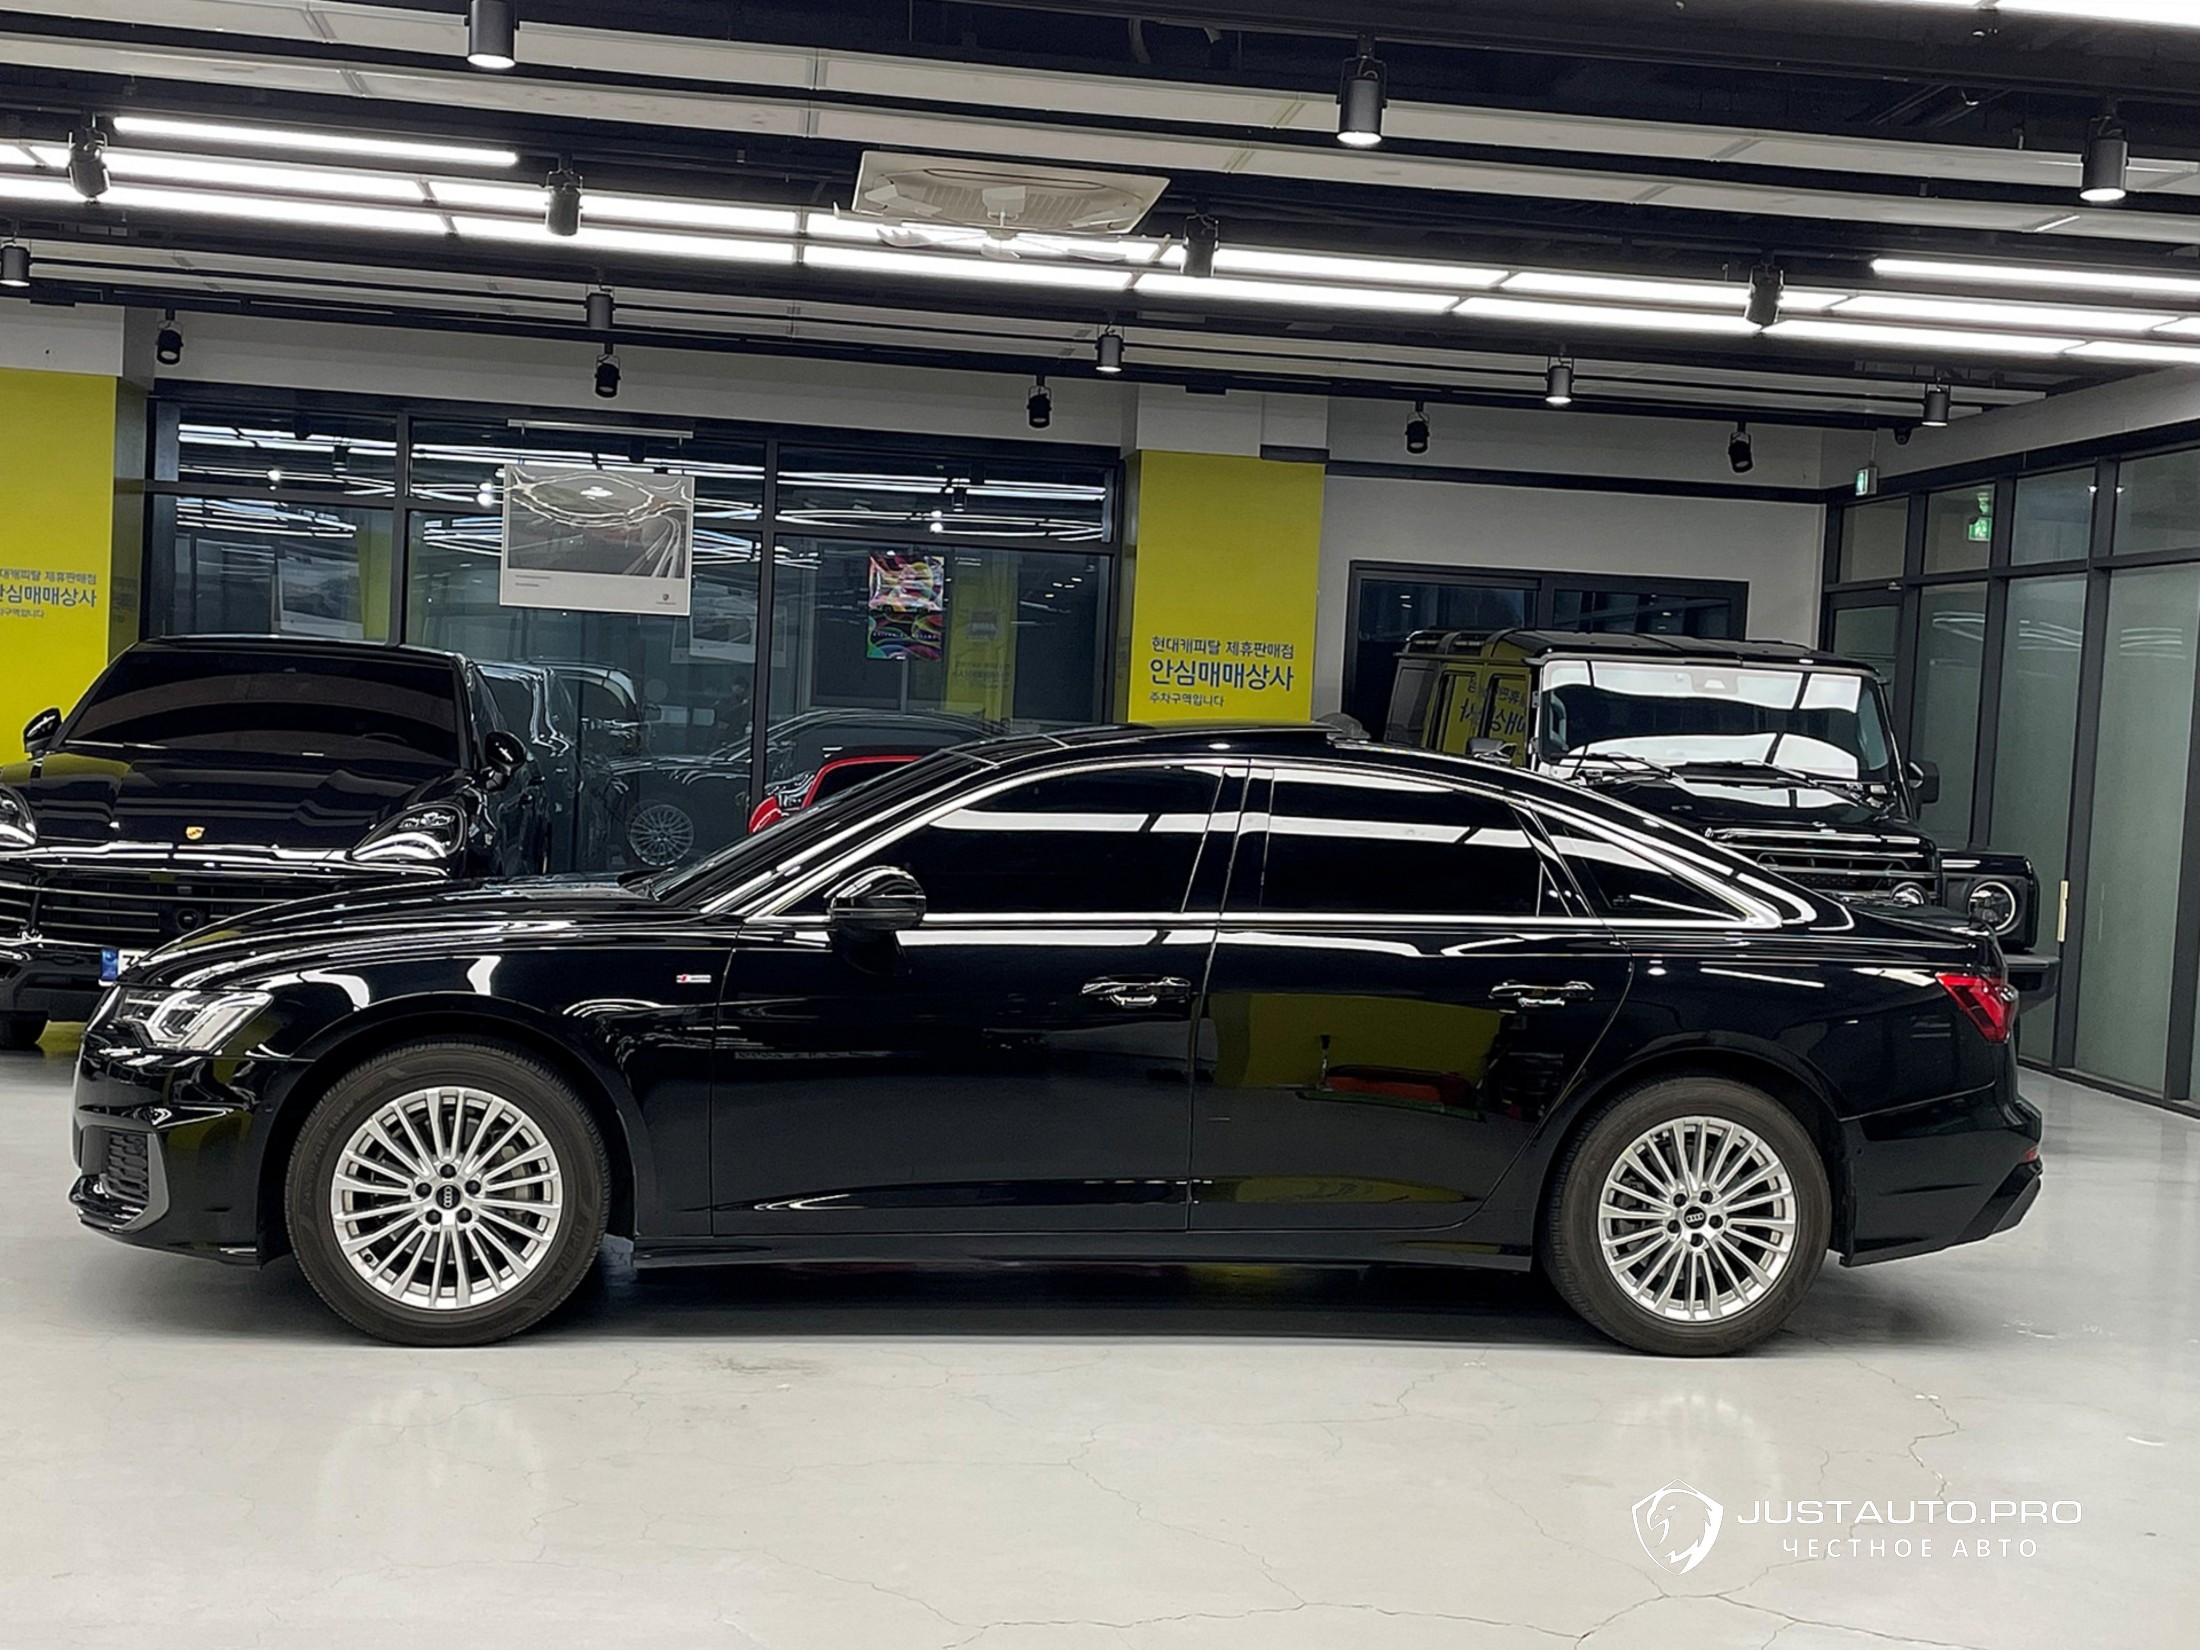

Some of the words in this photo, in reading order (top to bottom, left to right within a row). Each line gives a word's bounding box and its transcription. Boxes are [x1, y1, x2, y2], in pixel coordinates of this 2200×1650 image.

[1152, 636, 1221, 655] 현대캐피탈
[1226, 641, 1294, 660] 제휴판매점
[1150, 659, 1294, 691] 안심매매상사
[1149, 691, 1224, 707] 주차구역입니다
